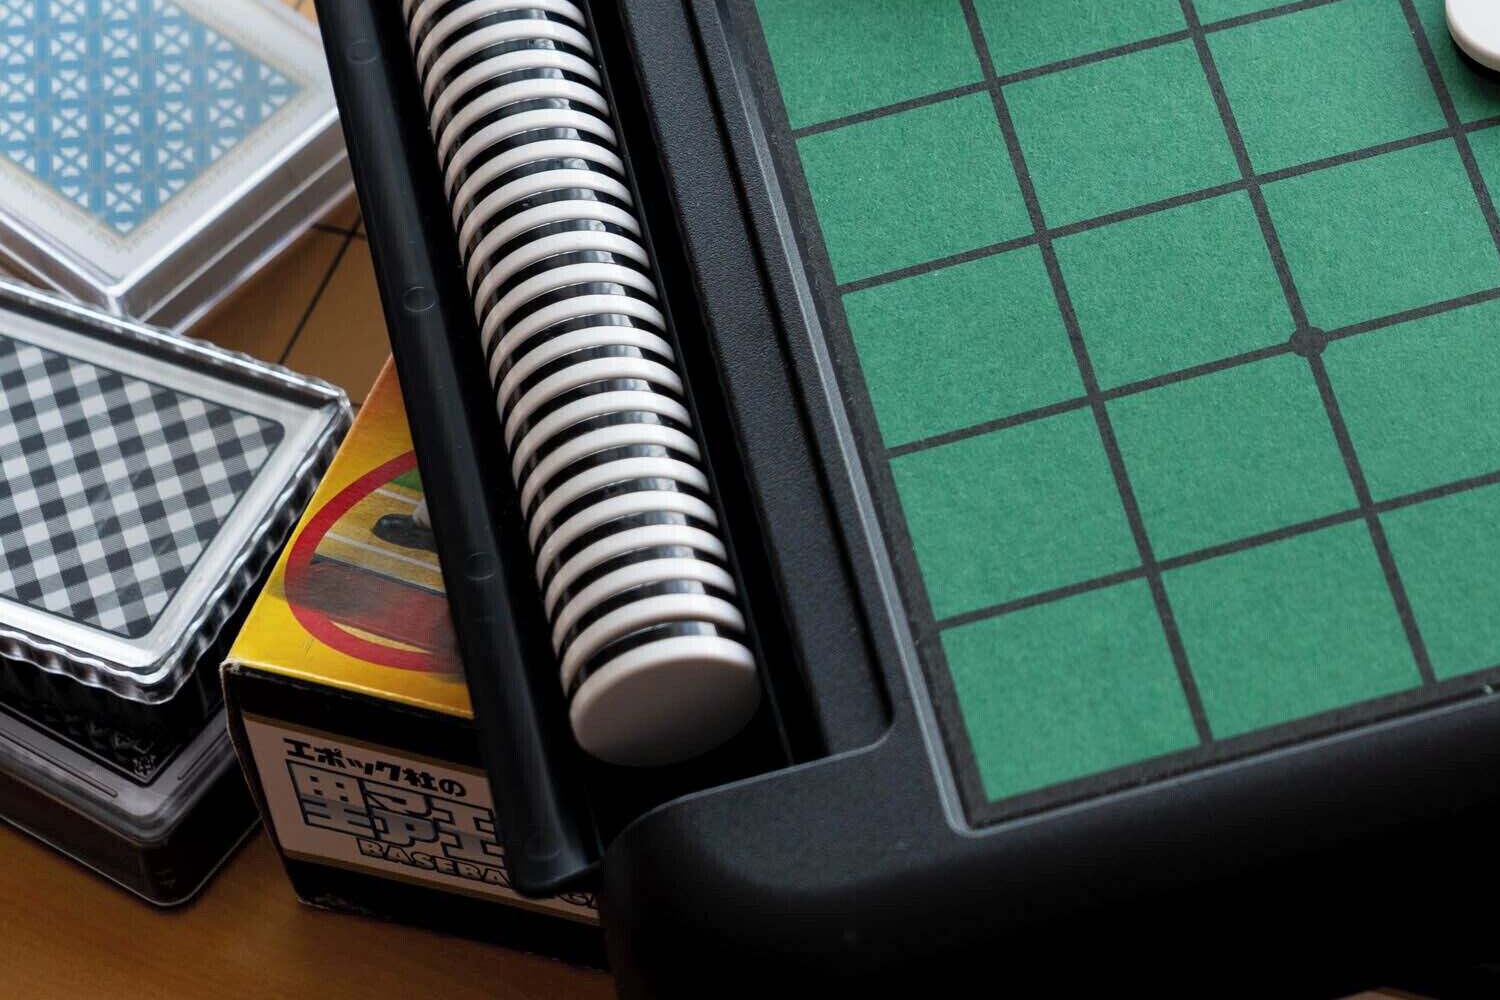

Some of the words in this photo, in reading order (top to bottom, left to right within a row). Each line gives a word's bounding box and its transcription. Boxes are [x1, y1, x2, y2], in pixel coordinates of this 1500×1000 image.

[284, 737, 467, 798] エポック社の
